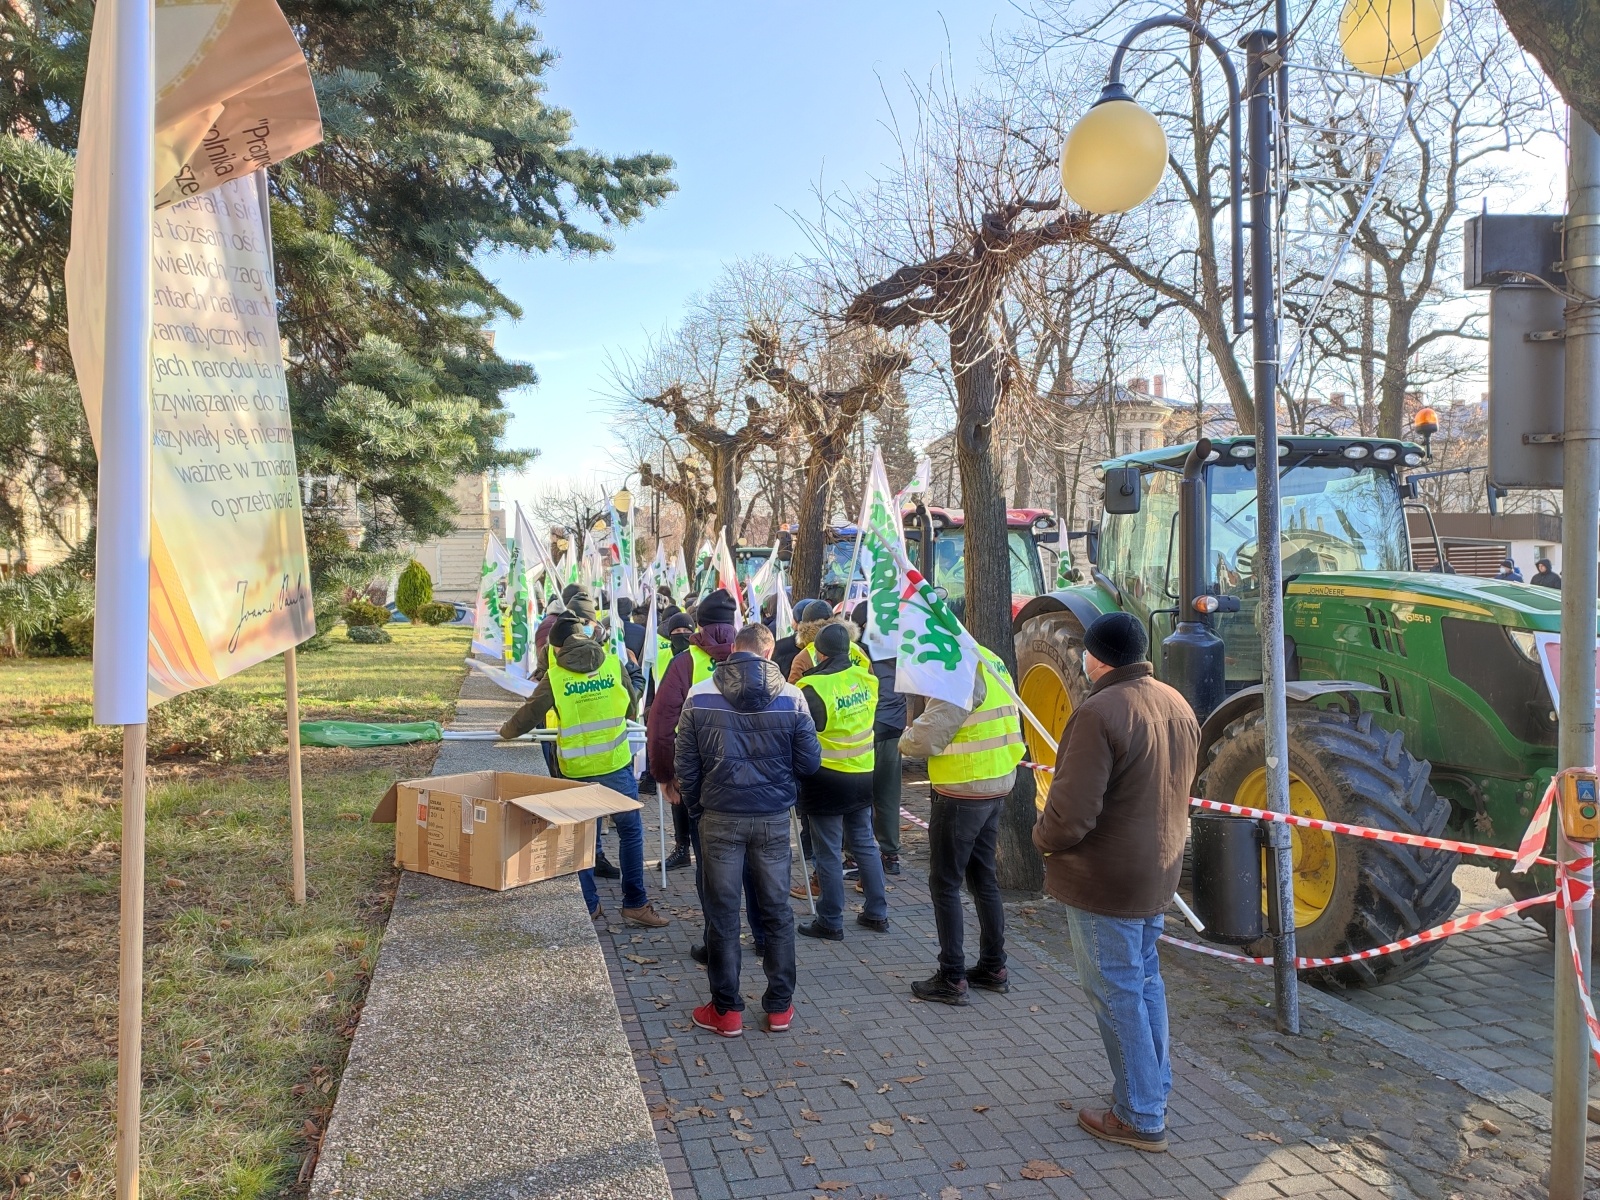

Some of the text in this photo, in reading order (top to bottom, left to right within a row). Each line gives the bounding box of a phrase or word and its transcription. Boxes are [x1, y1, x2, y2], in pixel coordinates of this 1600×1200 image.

[154, 250, 228, 281] wielkich
[154, 322, 268, 353] ramatycznych
[192, 356, 254, 379] narodu
[254, 359, 273, 379] ta
[152, 387, 250, 419] rzywiązanie
[253, 389, 275, 411] do
[224, 422, 249, 450] się
[175, 458, 233, 484] ważne
[233, 462, 250, 478] w
[211, 499, 225, 517] o
[1307, 586, 1345, 596] JOHN DEERE
